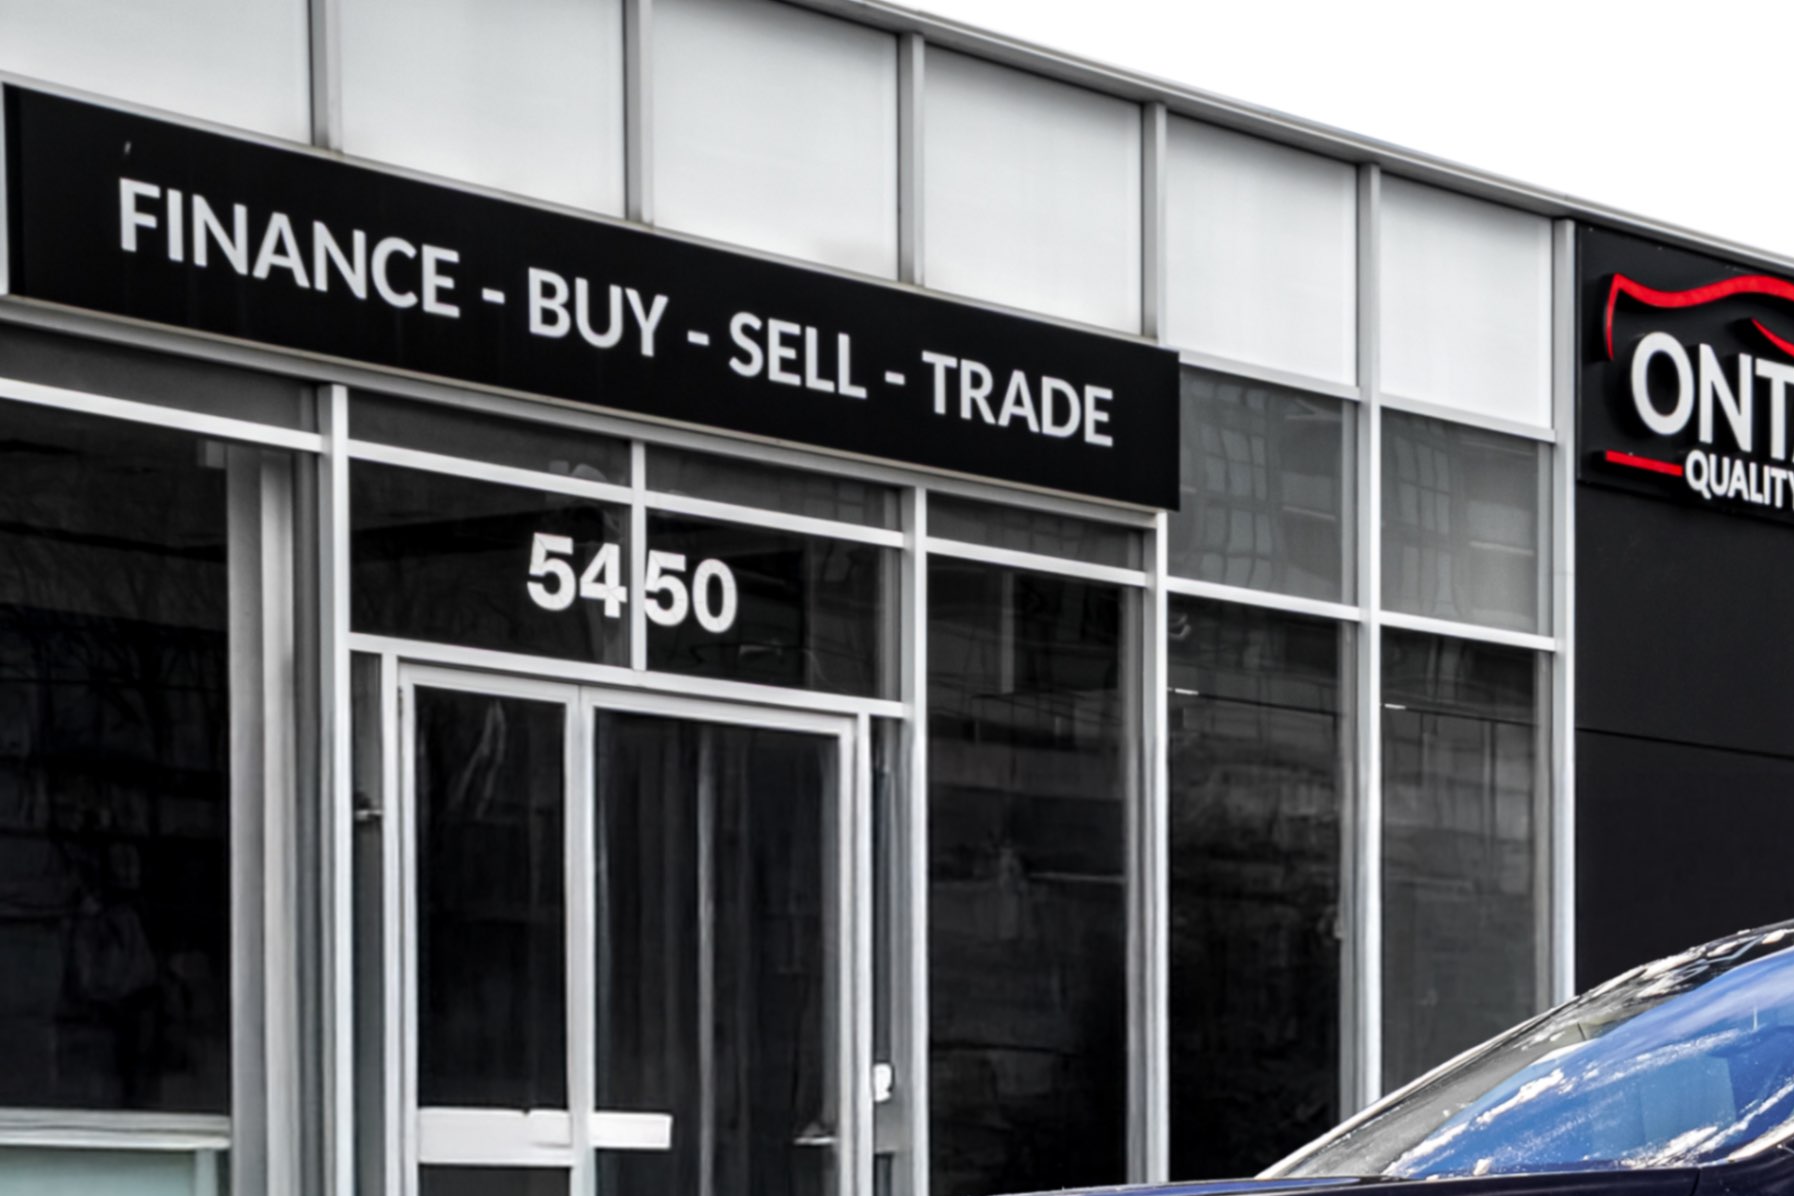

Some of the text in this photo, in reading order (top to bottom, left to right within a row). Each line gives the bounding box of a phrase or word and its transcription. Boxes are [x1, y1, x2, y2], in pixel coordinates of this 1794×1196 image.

[119, 177, 460, 318] FINANCE
[528, 267, 669, 357] BUY
[729, 311, 867, 399] SELL
[921, 350, 1113, 448] TRADE
[527, 532, 737, 634] 5450
